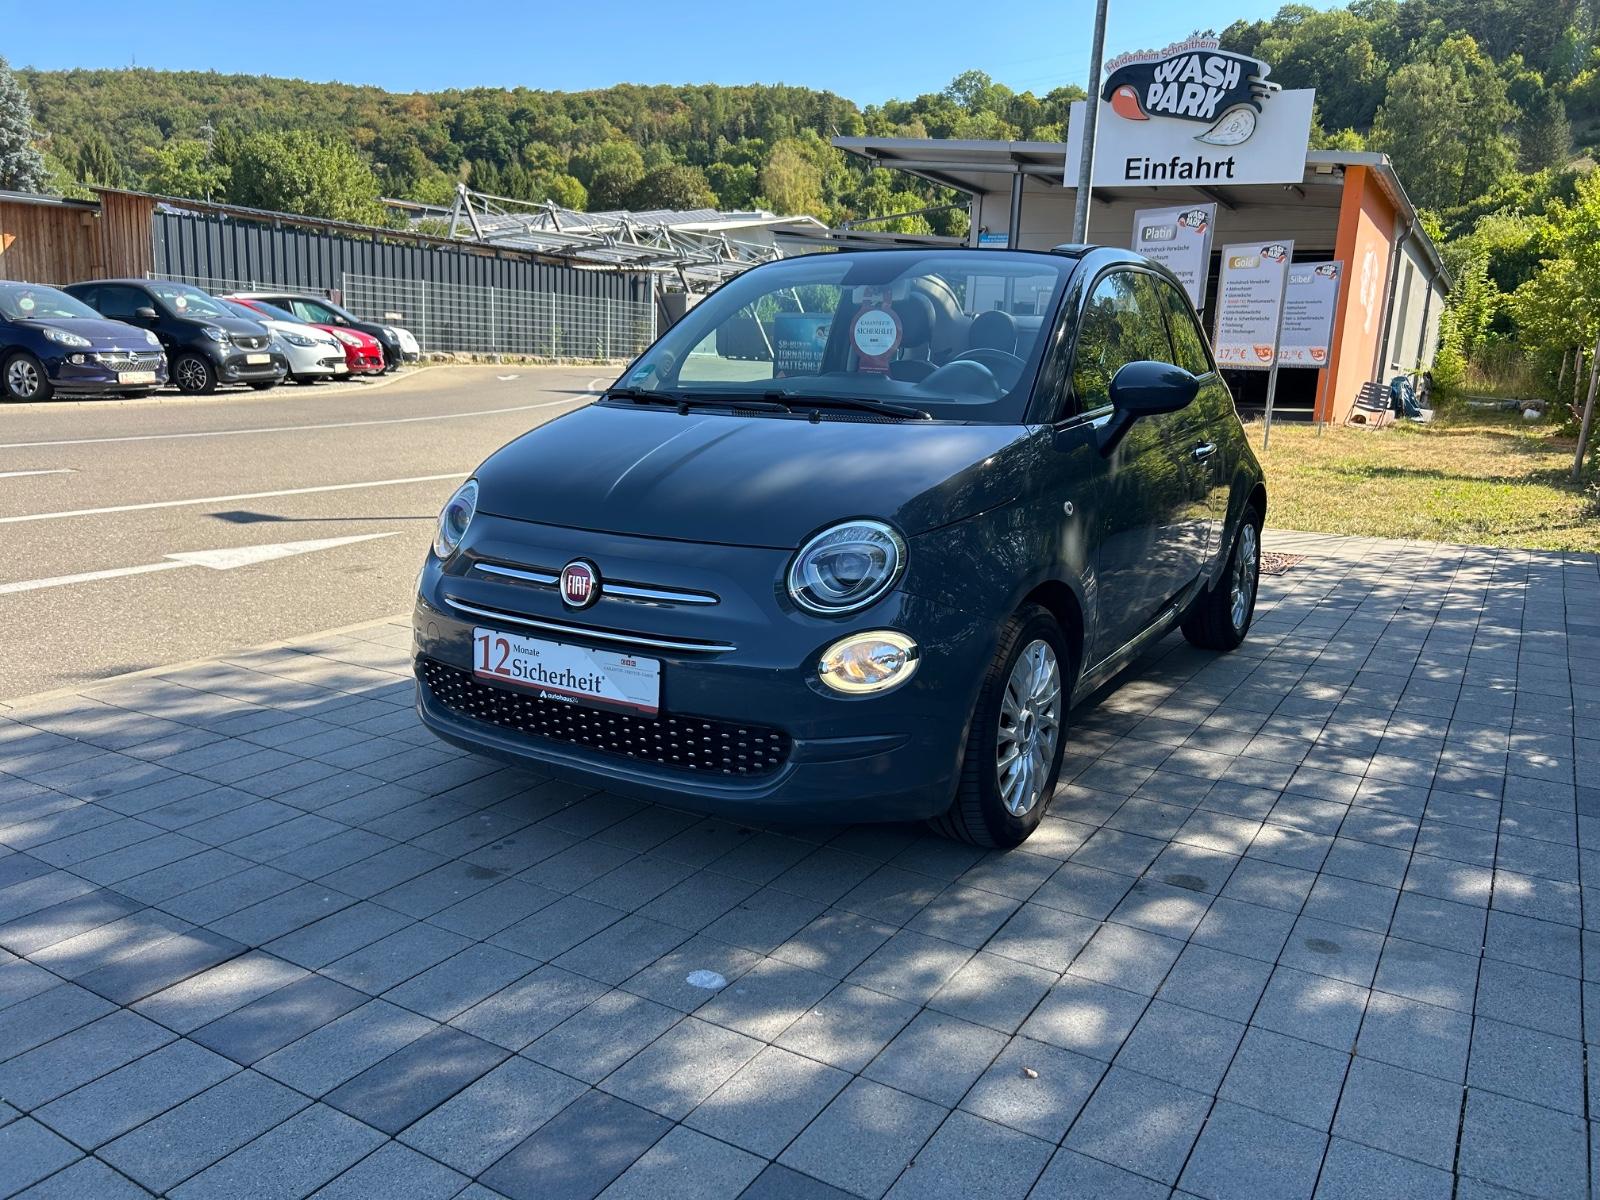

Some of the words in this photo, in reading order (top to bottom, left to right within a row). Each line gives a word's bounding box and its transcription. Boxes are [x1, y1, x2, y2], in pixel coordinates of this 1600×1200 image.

[1106, 51, 1159, 72] Heidenheim
[1161, 39, 1217, 59] Schnaitheim
[1153, 54, 1241, 90] WASH
[1146, 82, 1226, 118] PARK
[1124, 156, 1235, 180] Einfahrt
[1145, 227, 1172, 240] Platin
[1234, 258, 1254, 267] Gold
[1290, 275, 1310, 283] Silber
[857, 327, 893, 335] SICHERHEIT
[778, 349, 812, 360] TORNADO
[813, 350, 824, 361] UN
[567, 575, 588, 596] FIAT
[478, 634, 511, 677] 12
[513, 644, 540, 657] Monate
